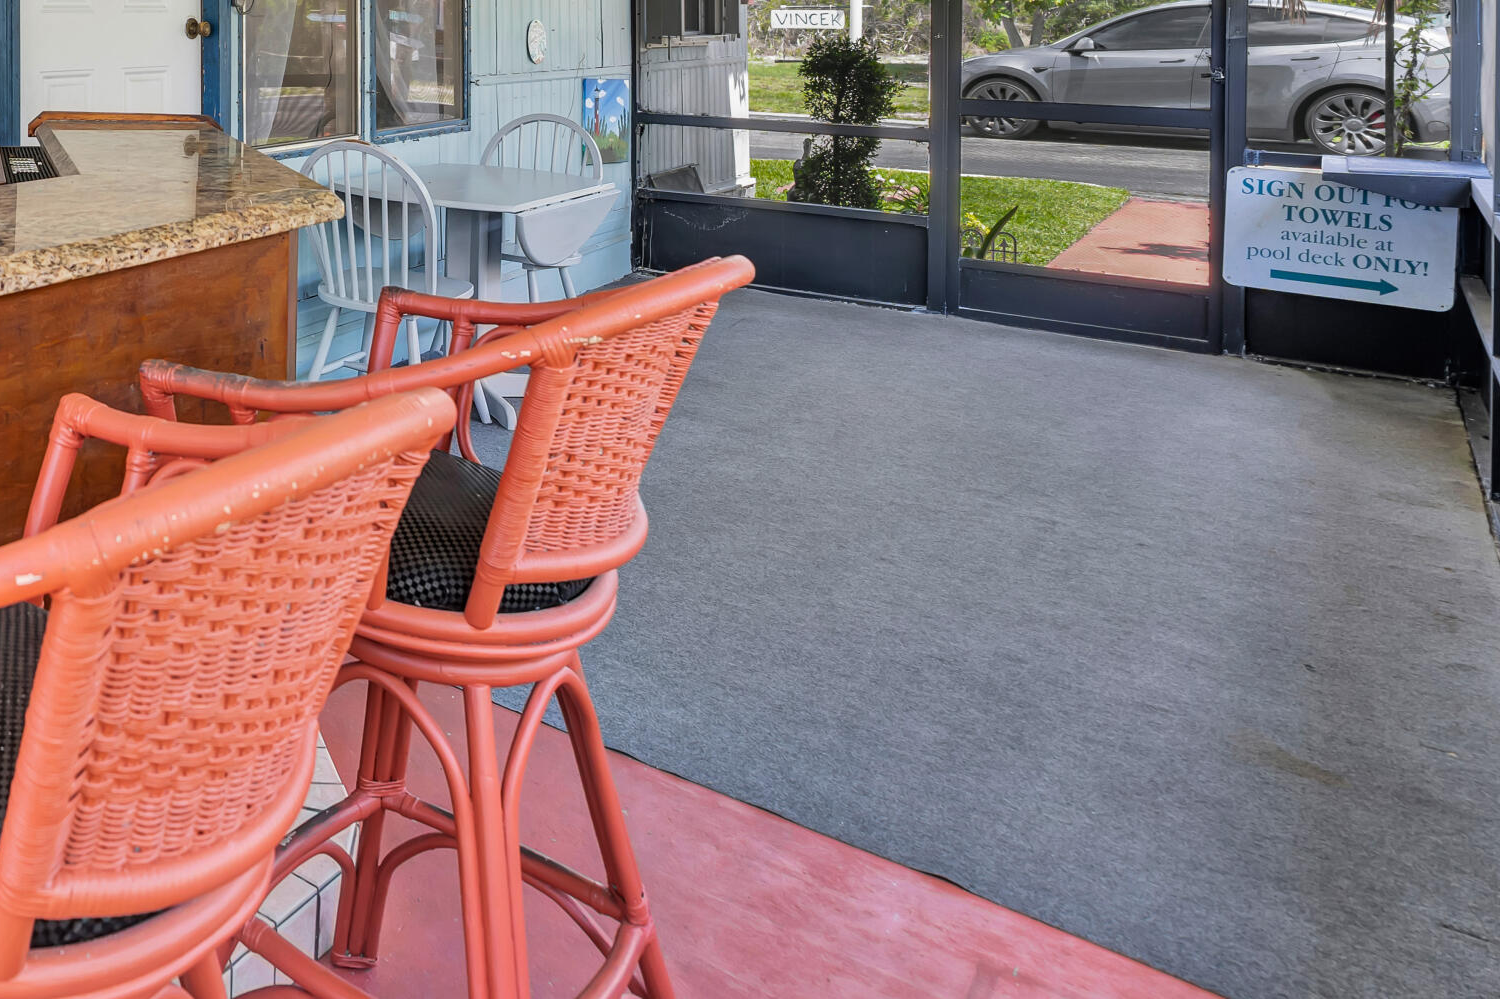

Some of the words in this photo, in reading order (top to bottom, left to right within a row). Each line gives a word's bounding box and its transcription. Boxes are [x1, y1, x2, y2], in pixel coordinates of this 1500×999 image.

[775, 13, 843, 27] VINCEK
[1242, 177, 1304, 199] SIGN
[1314, 184, 1373, 206] OUT
[1282, 204, 1393, 232] TOWELS
[1280, 229, 1368, 250] available
[1375, 239, 1394, 252] at
[1247, 246, 1290, 261] pool
[1297, 250, 1344, 267] deck
[1352, 253, 1429, 277] ONLY!
